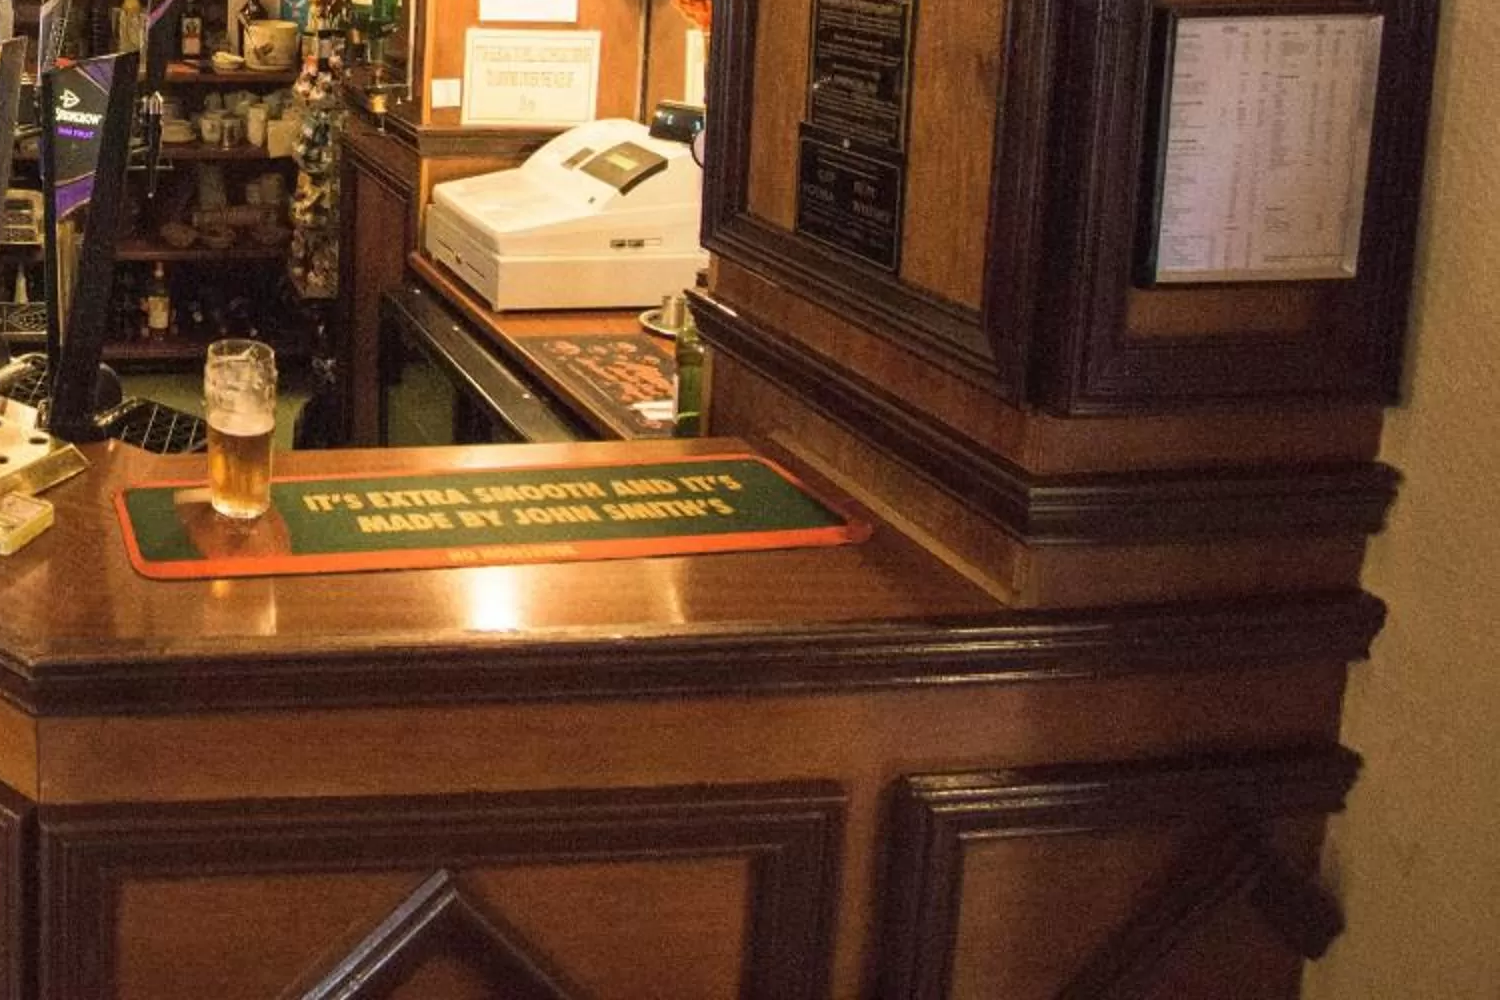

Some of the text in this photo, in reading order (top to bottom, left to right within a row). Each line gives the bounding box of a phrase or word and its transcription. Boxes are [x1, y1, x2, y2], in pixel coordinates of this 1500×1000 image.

[303, 474, 742, 512] IT'S EXTRA SMOOTH AND IT'S
[356, 498, 735, 533] MADE BY JOHN SMITH'S
